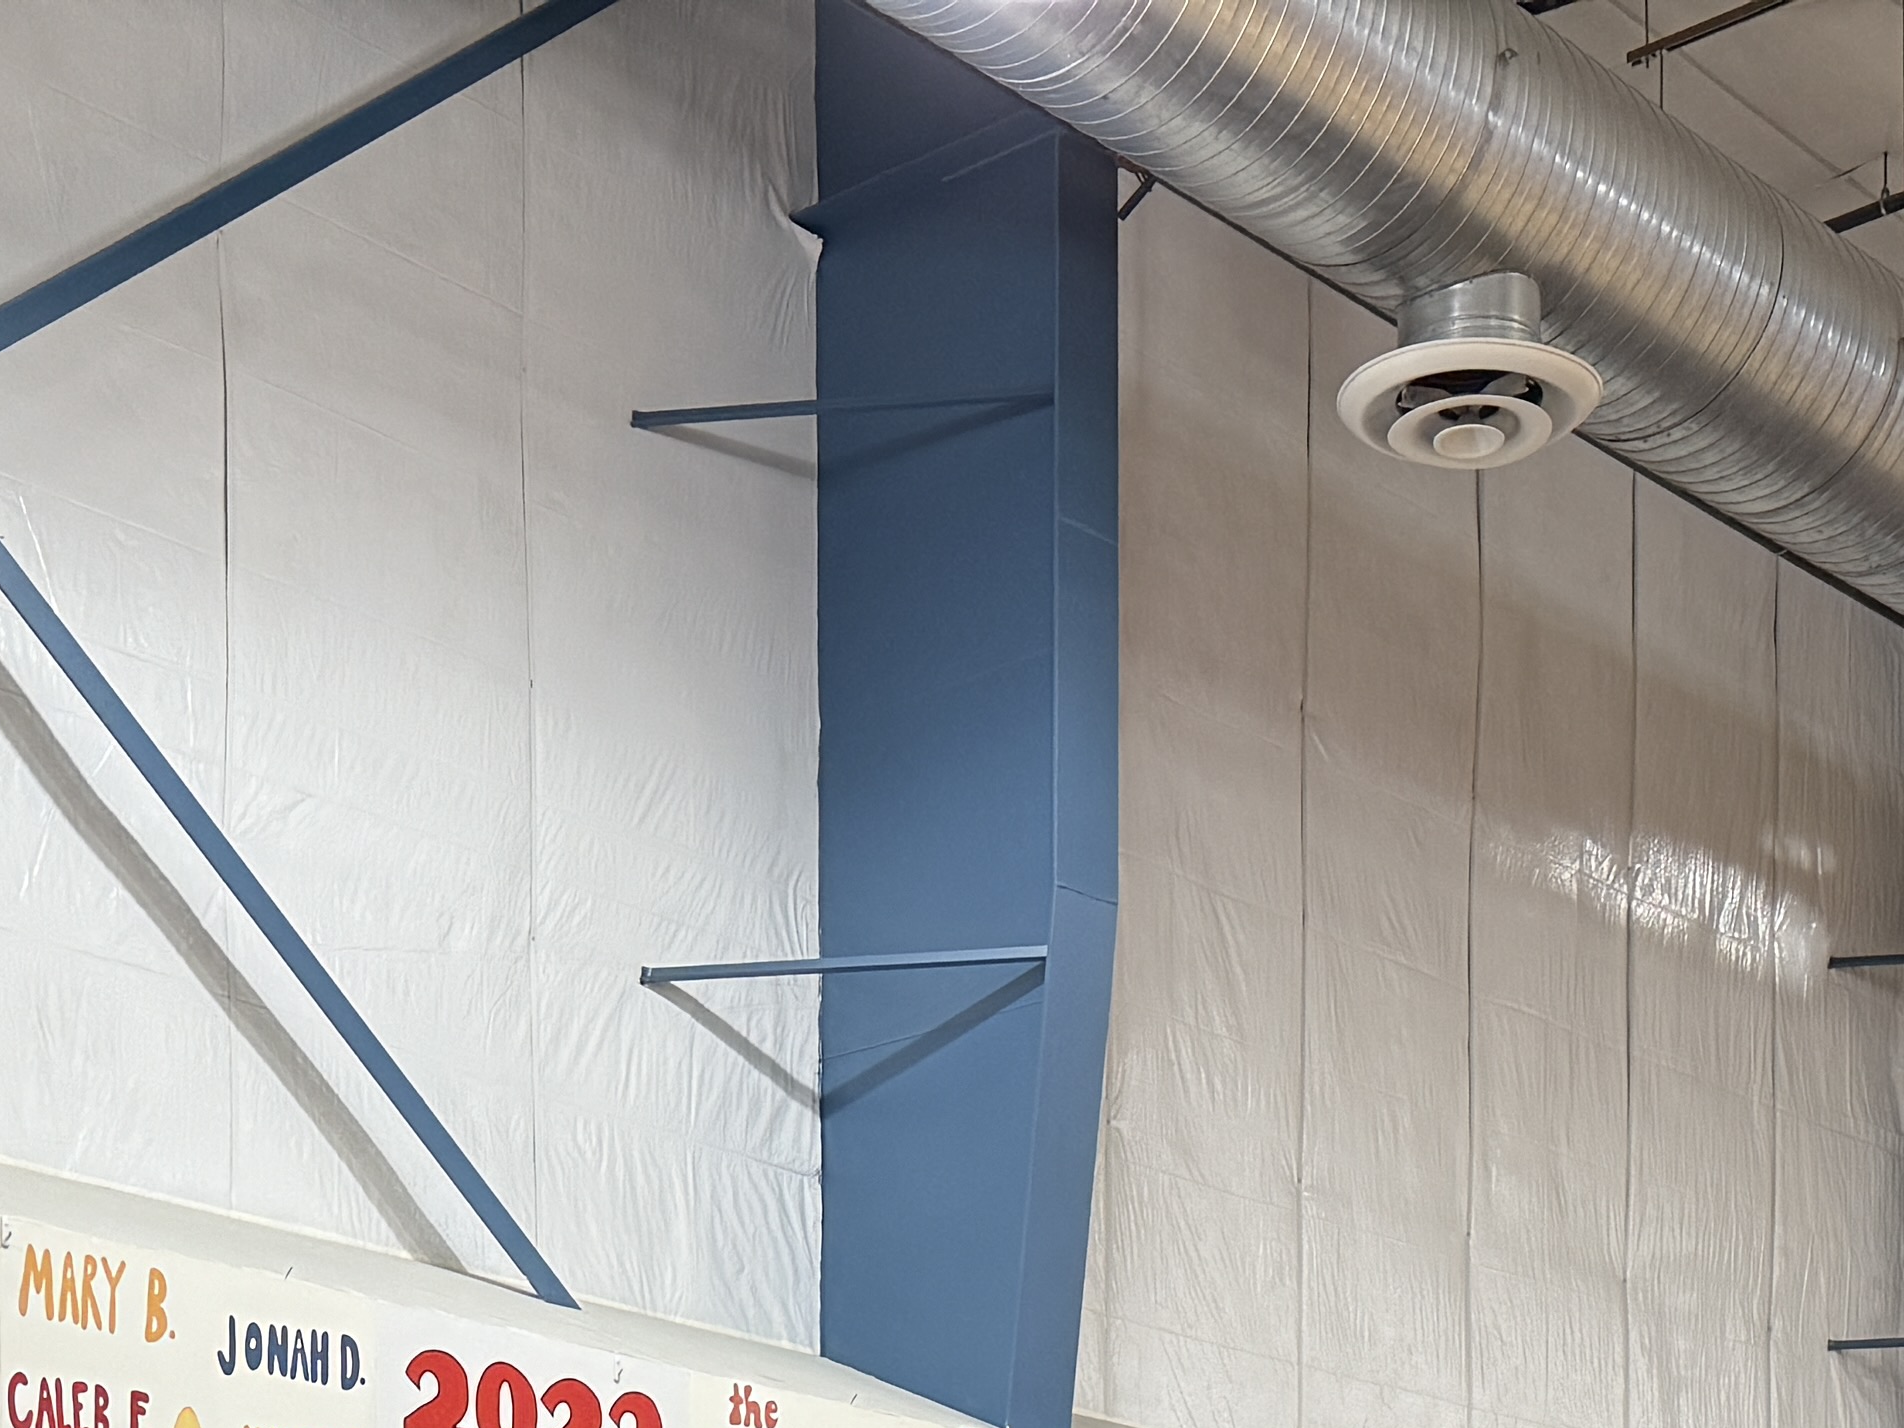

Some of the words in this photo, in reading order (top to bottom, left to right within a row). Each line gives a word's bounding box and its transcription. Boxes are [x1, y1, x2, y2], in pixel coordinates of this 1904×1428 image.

[18, 1244, 126, 1335] MARY
[144, 1267, 176, 1343] B.
[218, 1315, 328, 1385] JONAH
[340, 1334, 366, 1390] D.
